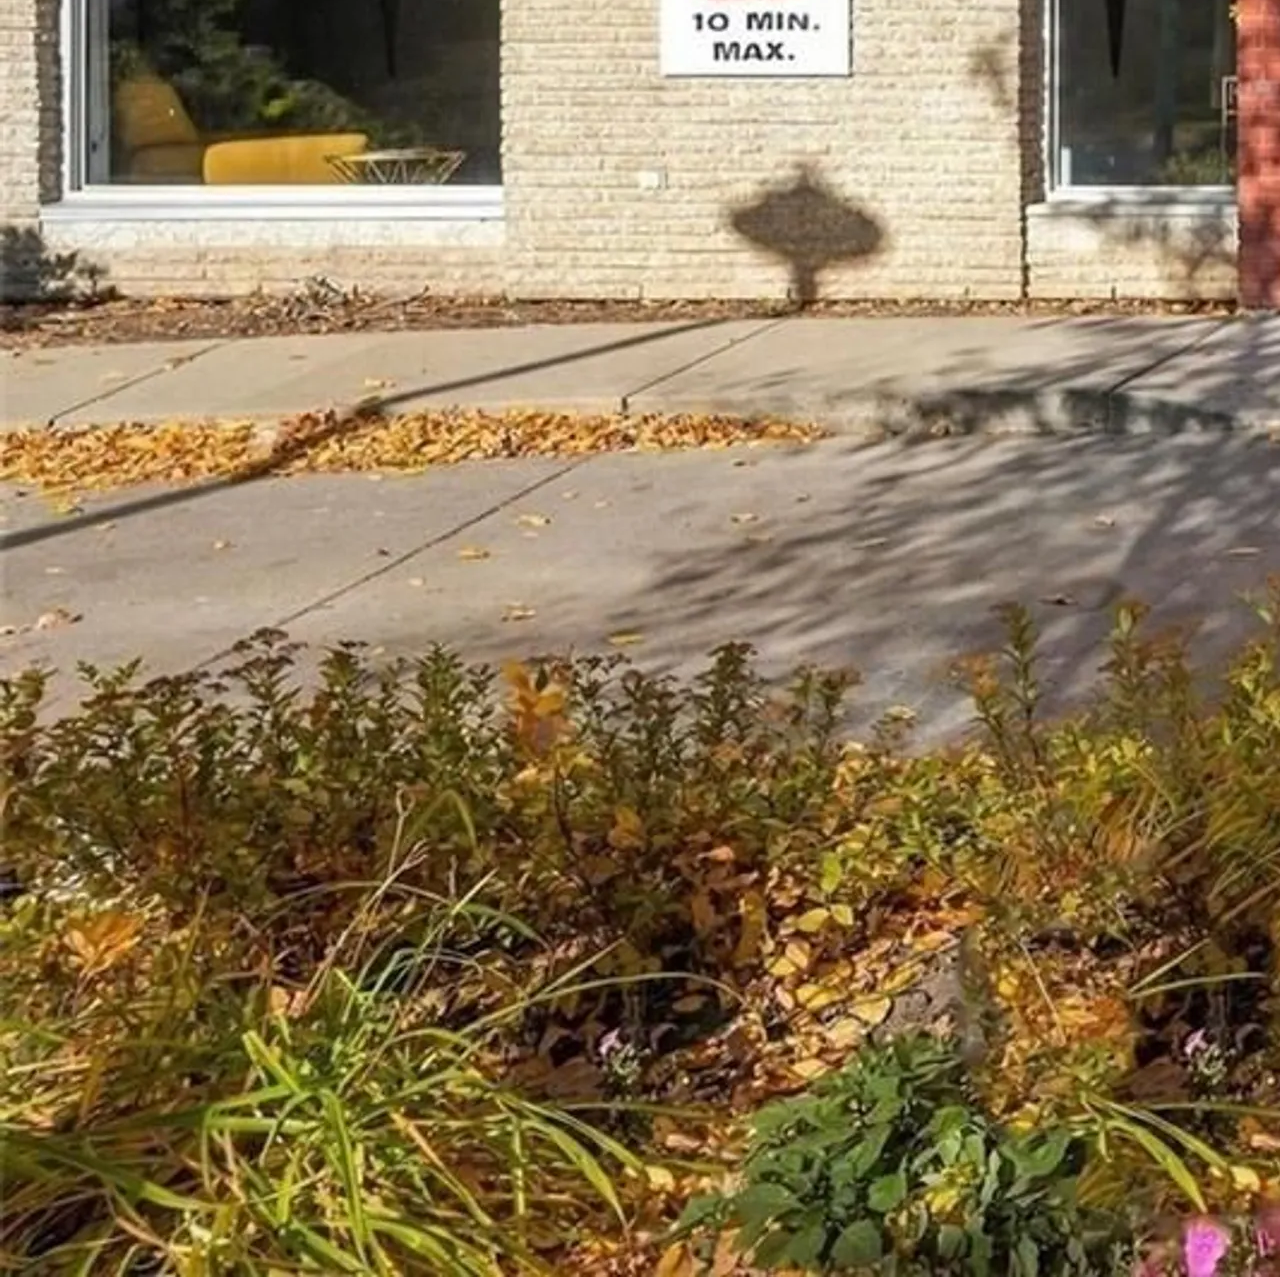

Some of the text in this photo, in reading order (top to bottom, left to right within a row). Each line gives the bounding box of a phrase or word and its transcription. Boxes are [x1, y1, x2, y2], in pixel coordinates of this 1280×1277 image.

[692, 11, 820, 32] 10 MIN.
[713, 41, 796, 62] MAX.
